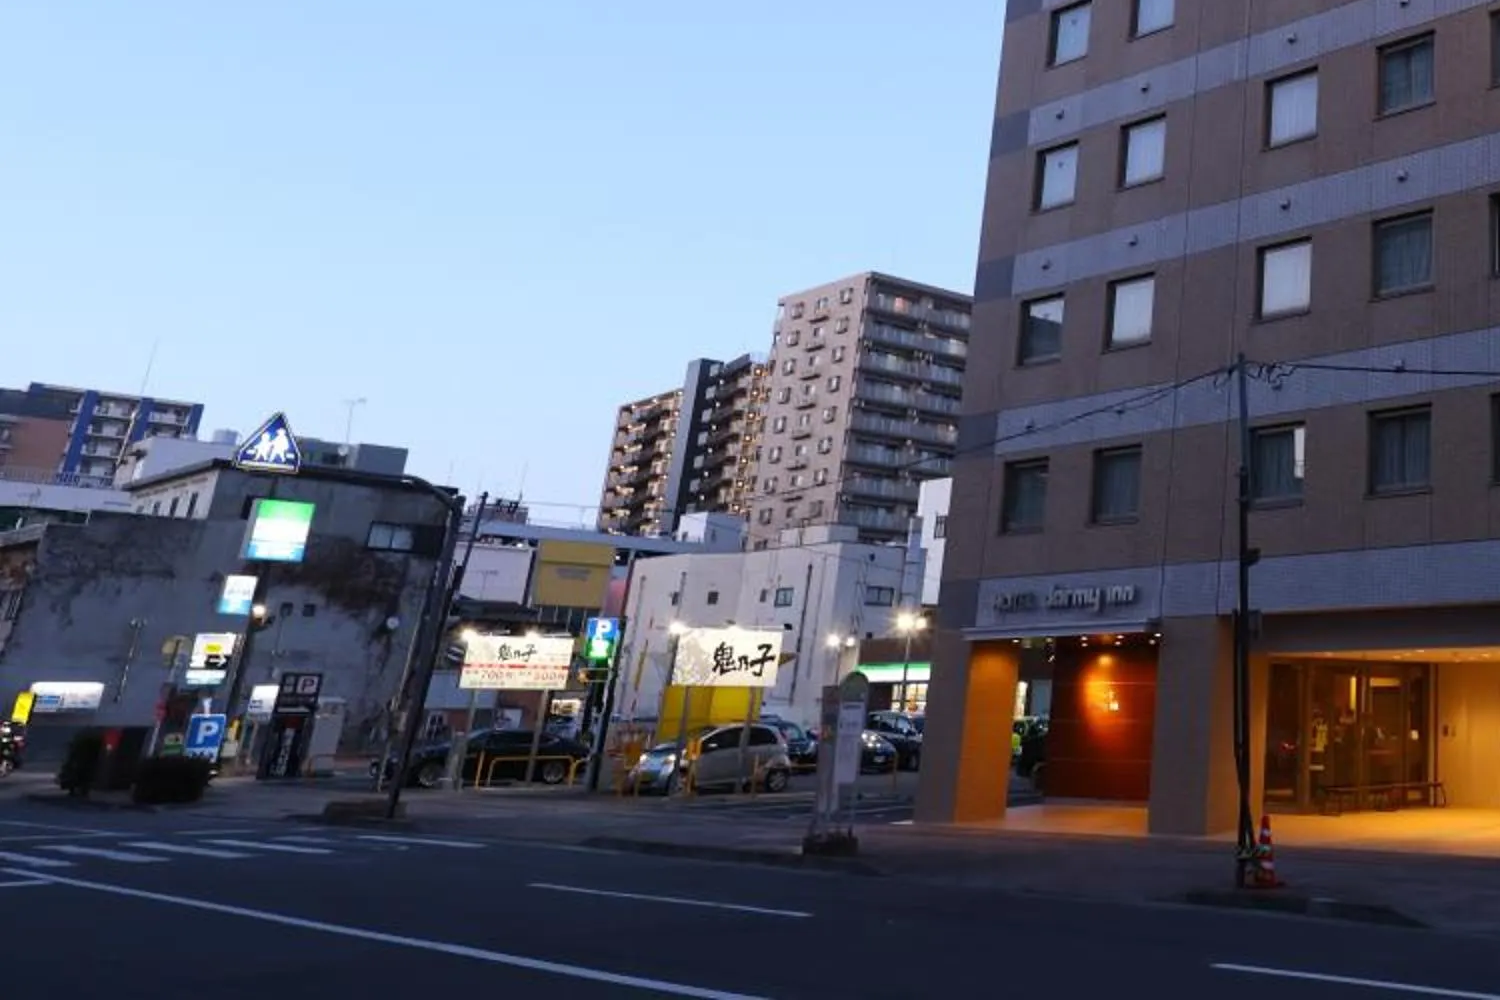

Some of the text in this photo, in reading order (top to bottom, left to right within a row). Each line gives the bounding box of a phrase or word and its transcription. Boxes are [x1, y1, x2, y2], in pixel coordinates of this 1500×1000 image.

[598, 620, 612, 639] P
[302, 678, 317, 694] P
[196, 722, 218, 745] P
